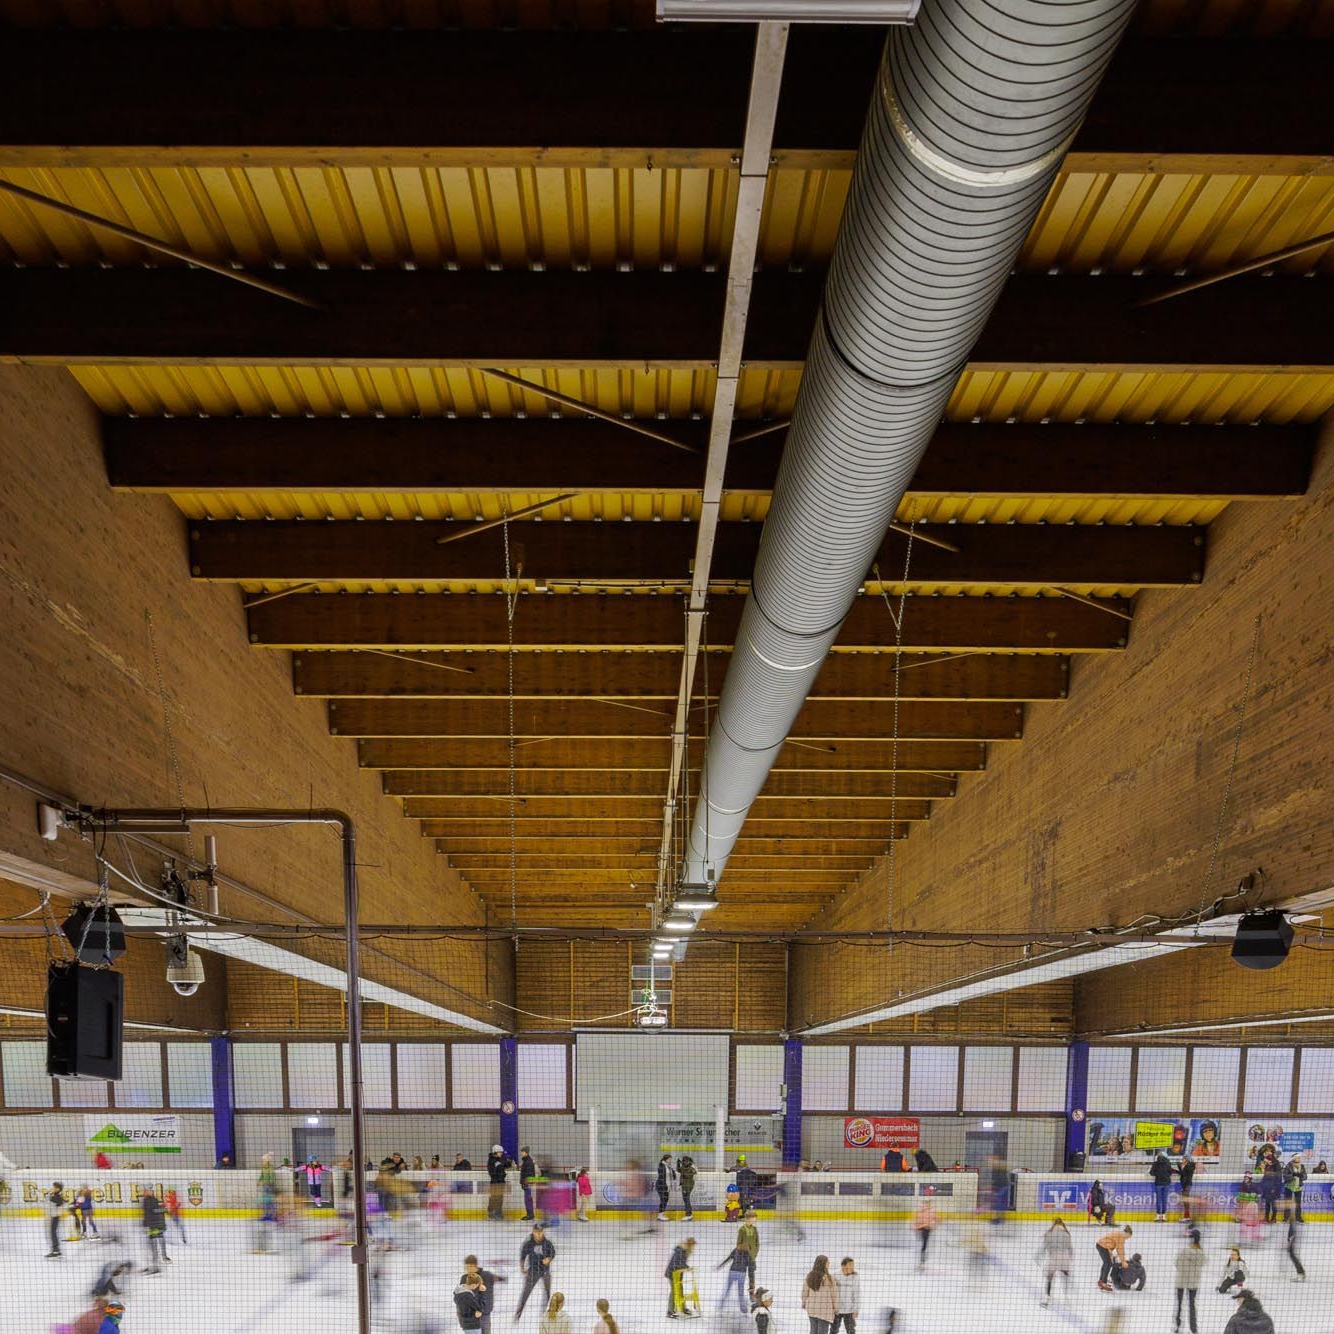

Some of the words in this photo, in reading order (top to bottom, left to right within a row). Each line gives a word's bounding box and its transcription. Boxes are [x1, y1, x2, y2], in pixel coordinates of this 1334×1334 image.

[695, 1126, 741, 1137] Schucher
[849, 1124, 871, 1134] BURGER
[875, 1123, 918, 1132] Gummersbach
[107, 1129, 176, 1138] BUBENZER
[850, 1128, 871, 1140] KING
[22, 1181, 123, 1206] Erqell
[1079, 1189, 1158, 1206] Vksban
